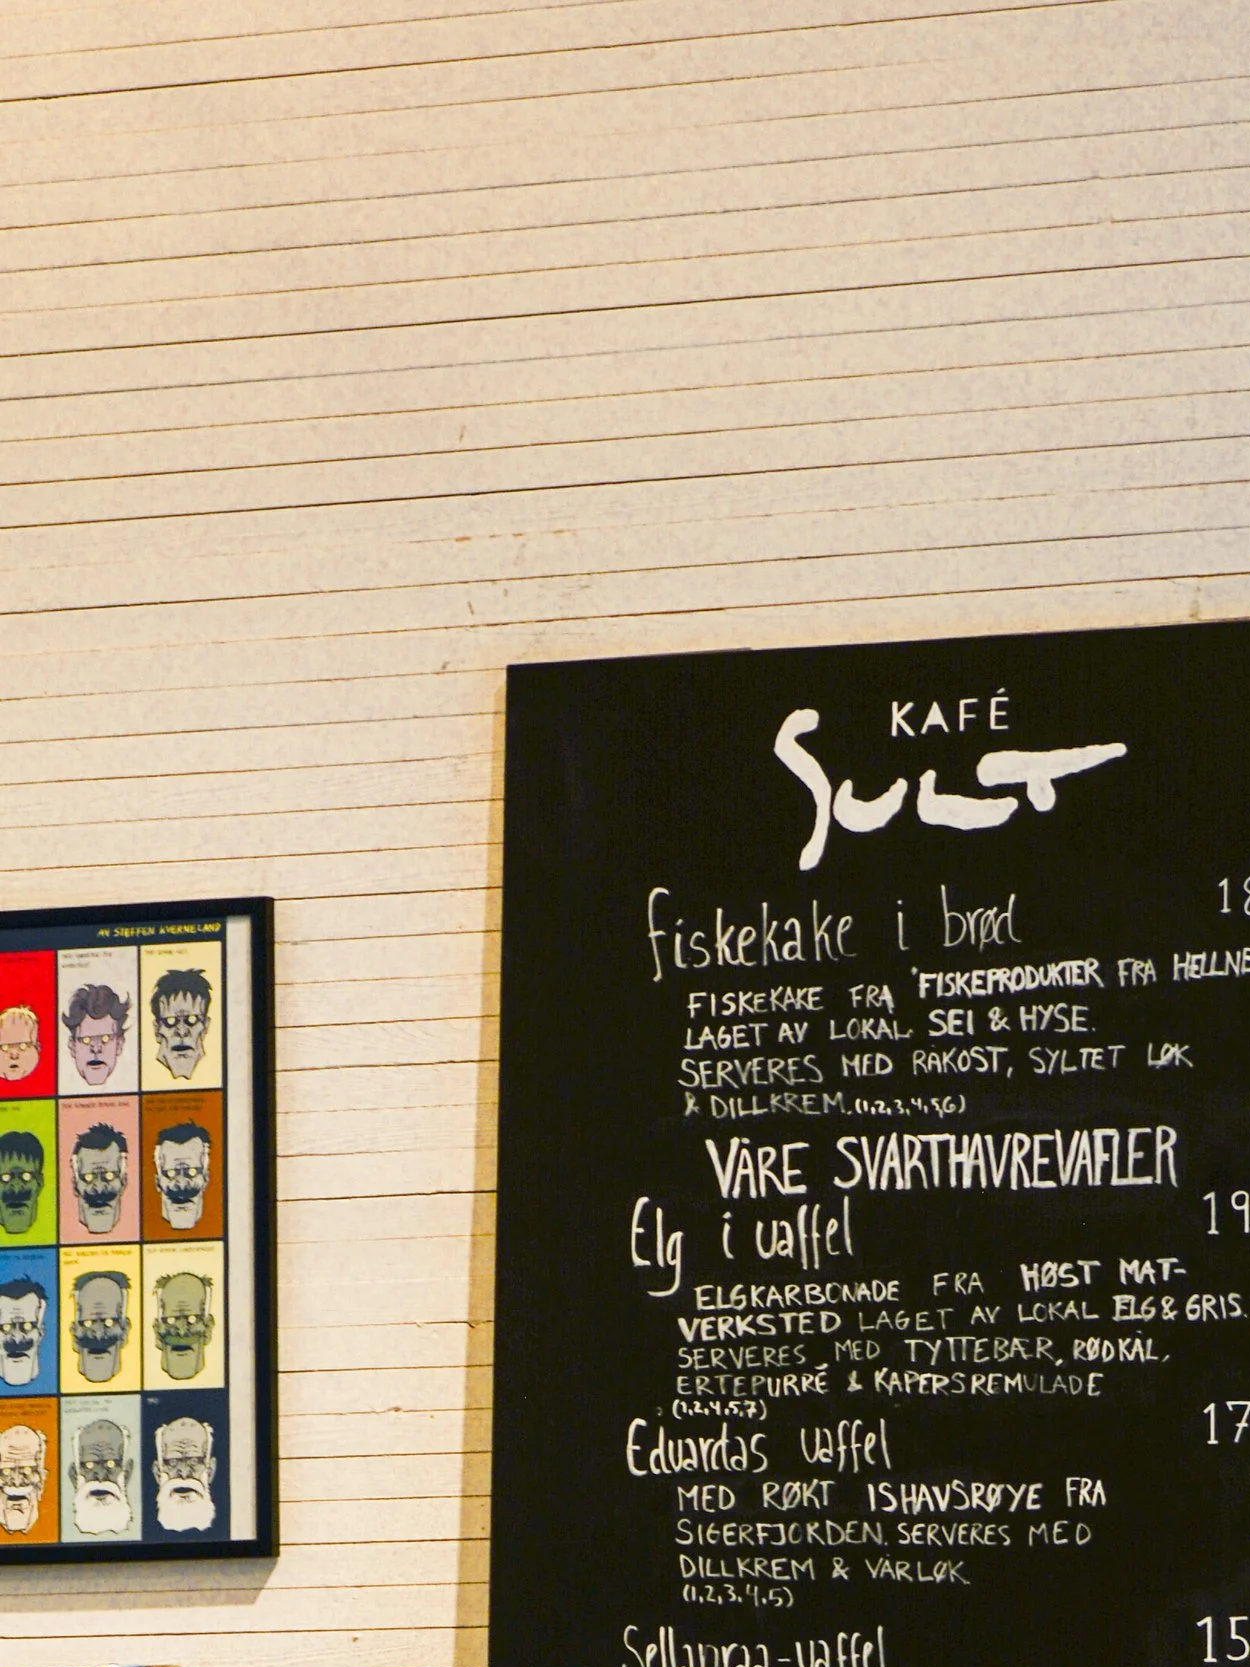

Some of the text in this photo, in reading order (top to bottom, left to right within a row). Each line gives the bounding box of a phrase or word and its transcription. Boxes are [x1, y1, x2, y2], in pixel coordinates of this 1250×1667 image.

[890, 687, 1010, 738] KAFÉ
[896, 899, 909, 951] i
[940, 884, 1022, 951] brød
[686, 985, 824, 1019] FISKEKAKE
[848, 983, 895, 1015] FRA
[1117, 957, 1157, 988] FRA
[683, 1022, 769, 1051] LAGET
[777, 1021, 809, 1045] AV
[928, 1008, 975, 1037] SEI
[987, 1006, 1011, 1032] &
[1019, 1002, 1096, 1033] HYSE.
[677, 1054, 824, 1090] SERVERES
[841, 1052, 894, 1078] MED
[1028, 1044, 1126, 1075] SYLTET
[1147, 1042, 1194, 1070] LØK
[704, 1124, 1178, 1200] VÅRE SVARTHAVREVAFLER
[630, 1196, 685, 1298] Elg
[722, 1211, 734, 1260] i
[693, 1257, 1187, 1312] ELGKARBONADE FRA HØST MAT-
[677, 1310, 842, 1343] VERKSTED
[858, 1307, 954, 1332] LAGET
[970, 1305, 1001, 1326] AV
[1017, 1299, 1100, 1323] LOKAL
[677, 1344, 806, 1371] SERVERES
[834, 1338, 881, 1362] MED
[903, 1335, 1064, 1367] TYTTEBÆR,
[676, 1362, 1104, 1398] ERTEPURRÉ & KAPERSREMULADE
[676, 1476, 1107, 1516] MED RØKT ISHAVSRØYE FRA
[674, 1518, 1092, 1547] SIGERFJORDEN. SERVERES MED
[679, 1553, 816, 1581] DILLKREM
[831, 1556, 850, 1581] &
